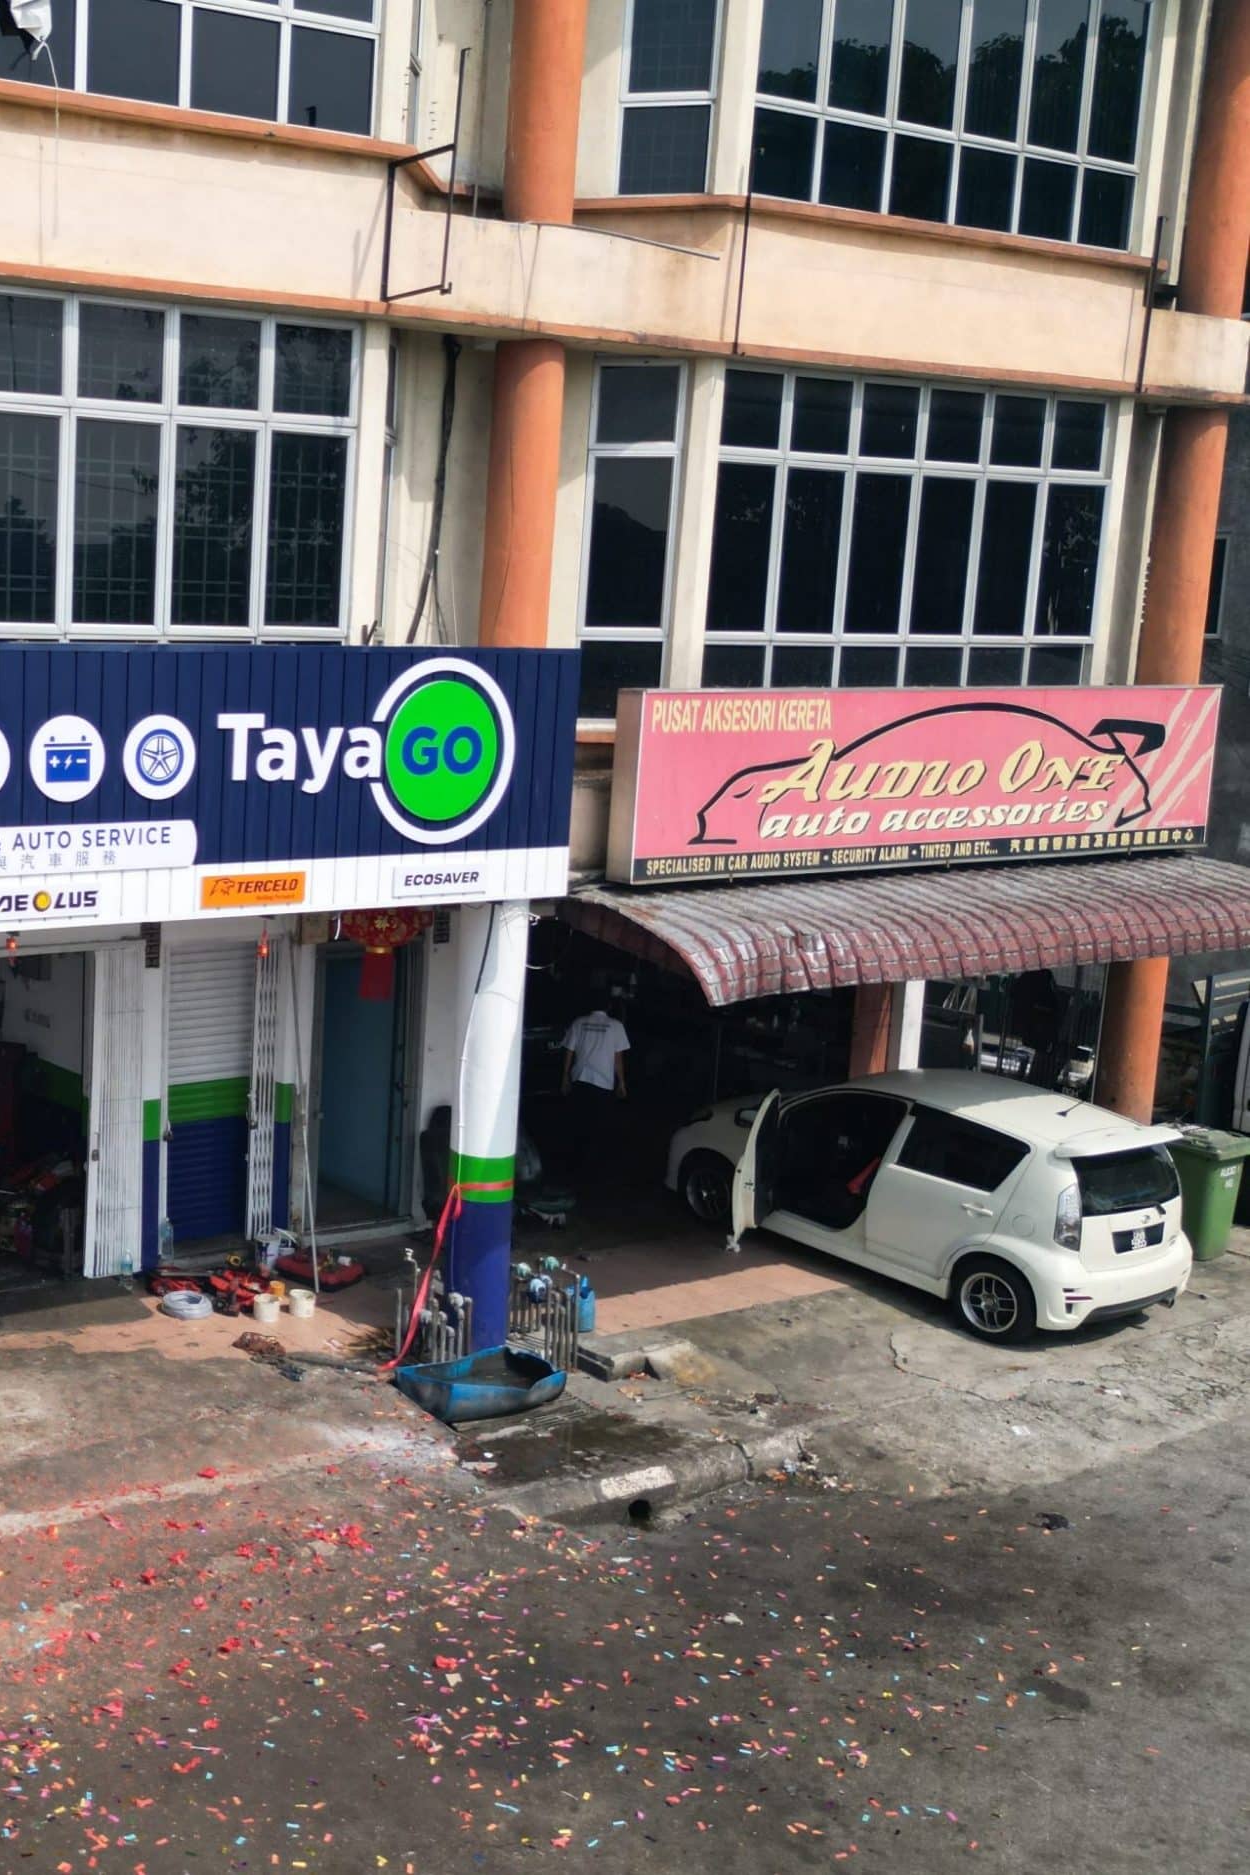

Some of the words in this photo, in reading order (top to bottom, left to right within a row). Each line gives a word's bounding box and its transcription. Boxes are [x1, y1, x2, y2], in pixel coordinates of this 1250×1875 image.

[652, 699, 702, 732] PUSAT
[701, 699, 776, 732] AKSESORI
[778, 699, 833, 731] KERETA
[760, 804, 870, 839] auto
[879, 796, 1108, 833] accessories
[12, 831, 72, 850] AUTO
[82, 826, 171, 847] SERVICE
[646, 859, 711, 876] SPECIALISED
[714, 859, 725, 871] IN
[728, 857, 748, 871] CAR
[750, 855, 780, 870] AUDIO
[783, 852, 820, 867] SYSTEM
[832, 848, 877, 864] SECURITY
[879, 846, 909, 861] ALARM
[920, 843, 951, 859] TINTED
[954, 842, 972, 857] AND
[237, 878, 298, 894] TERCELO
[404, 871, 480, 886] ECOSAVER
